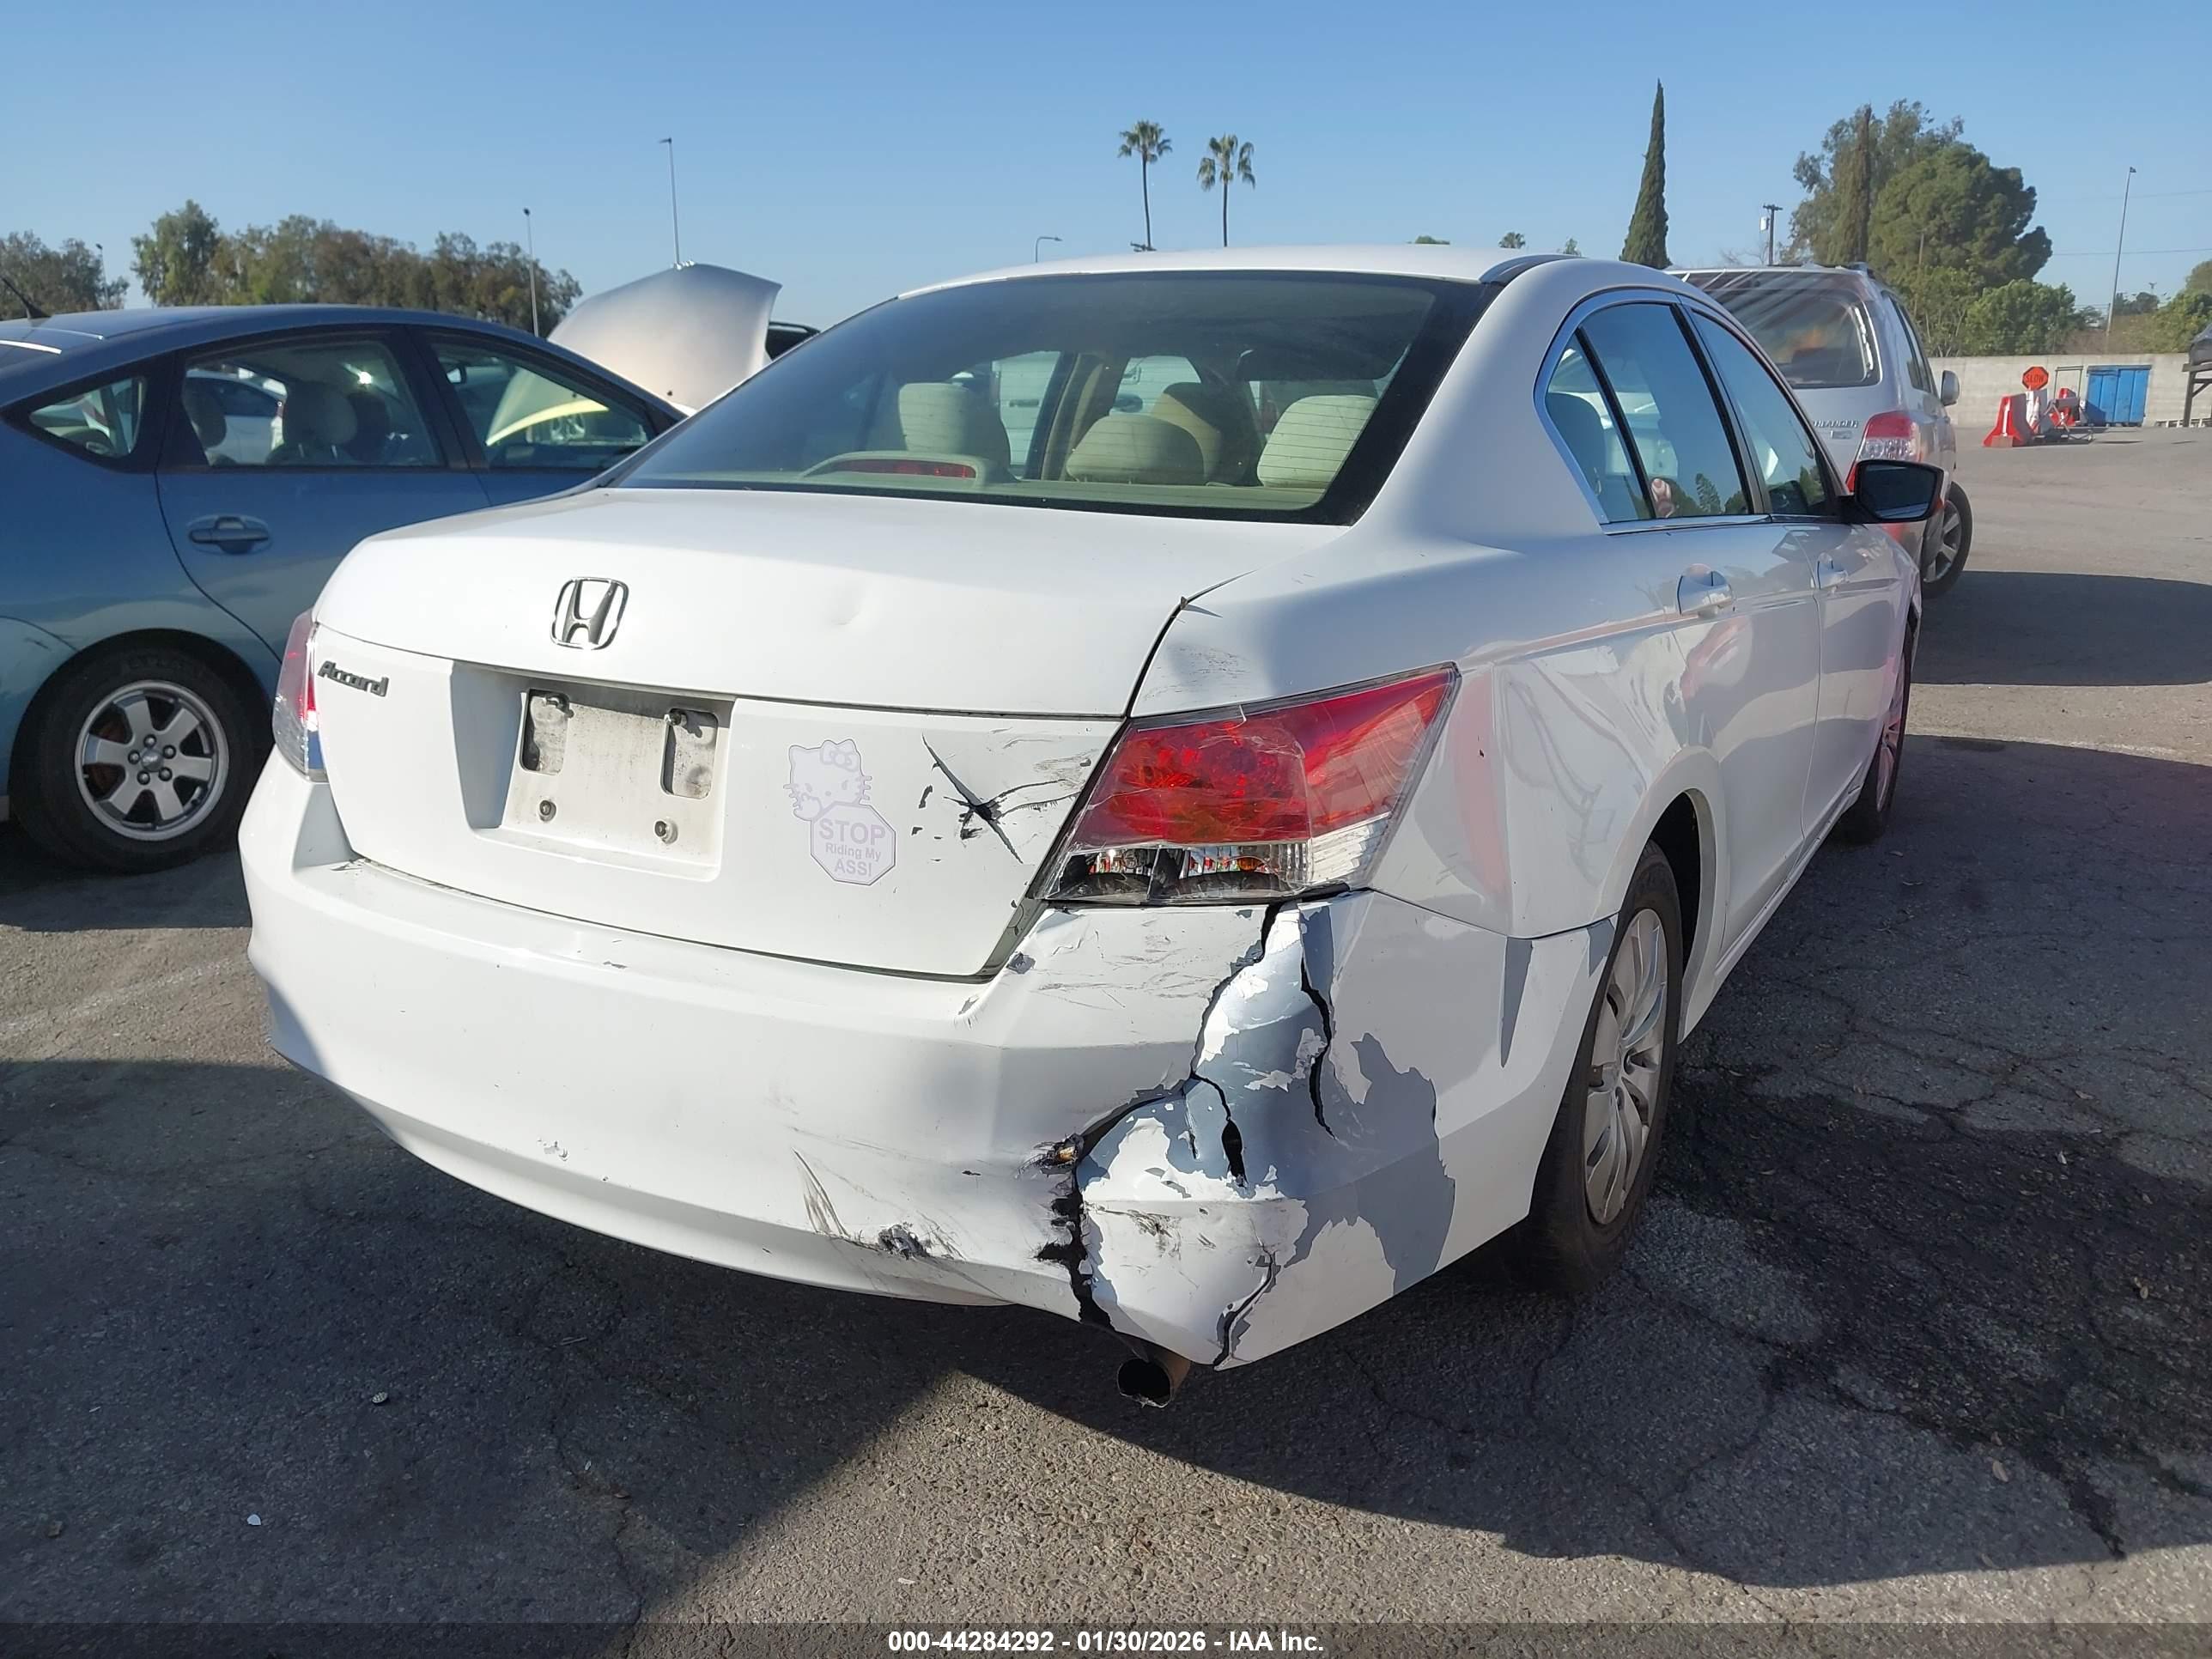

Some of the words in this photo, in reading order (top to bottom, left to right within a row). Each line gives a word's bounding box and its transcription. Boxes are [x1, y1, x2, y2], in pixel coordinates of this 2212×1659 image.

[2025, 374, 2045, 383] SLOW
[317, 660, 389, 696] Accord
[819, 817, 885, 845] STOP
[825, 842, 862, 860] Riding
[865, 847, 881, 862] My
